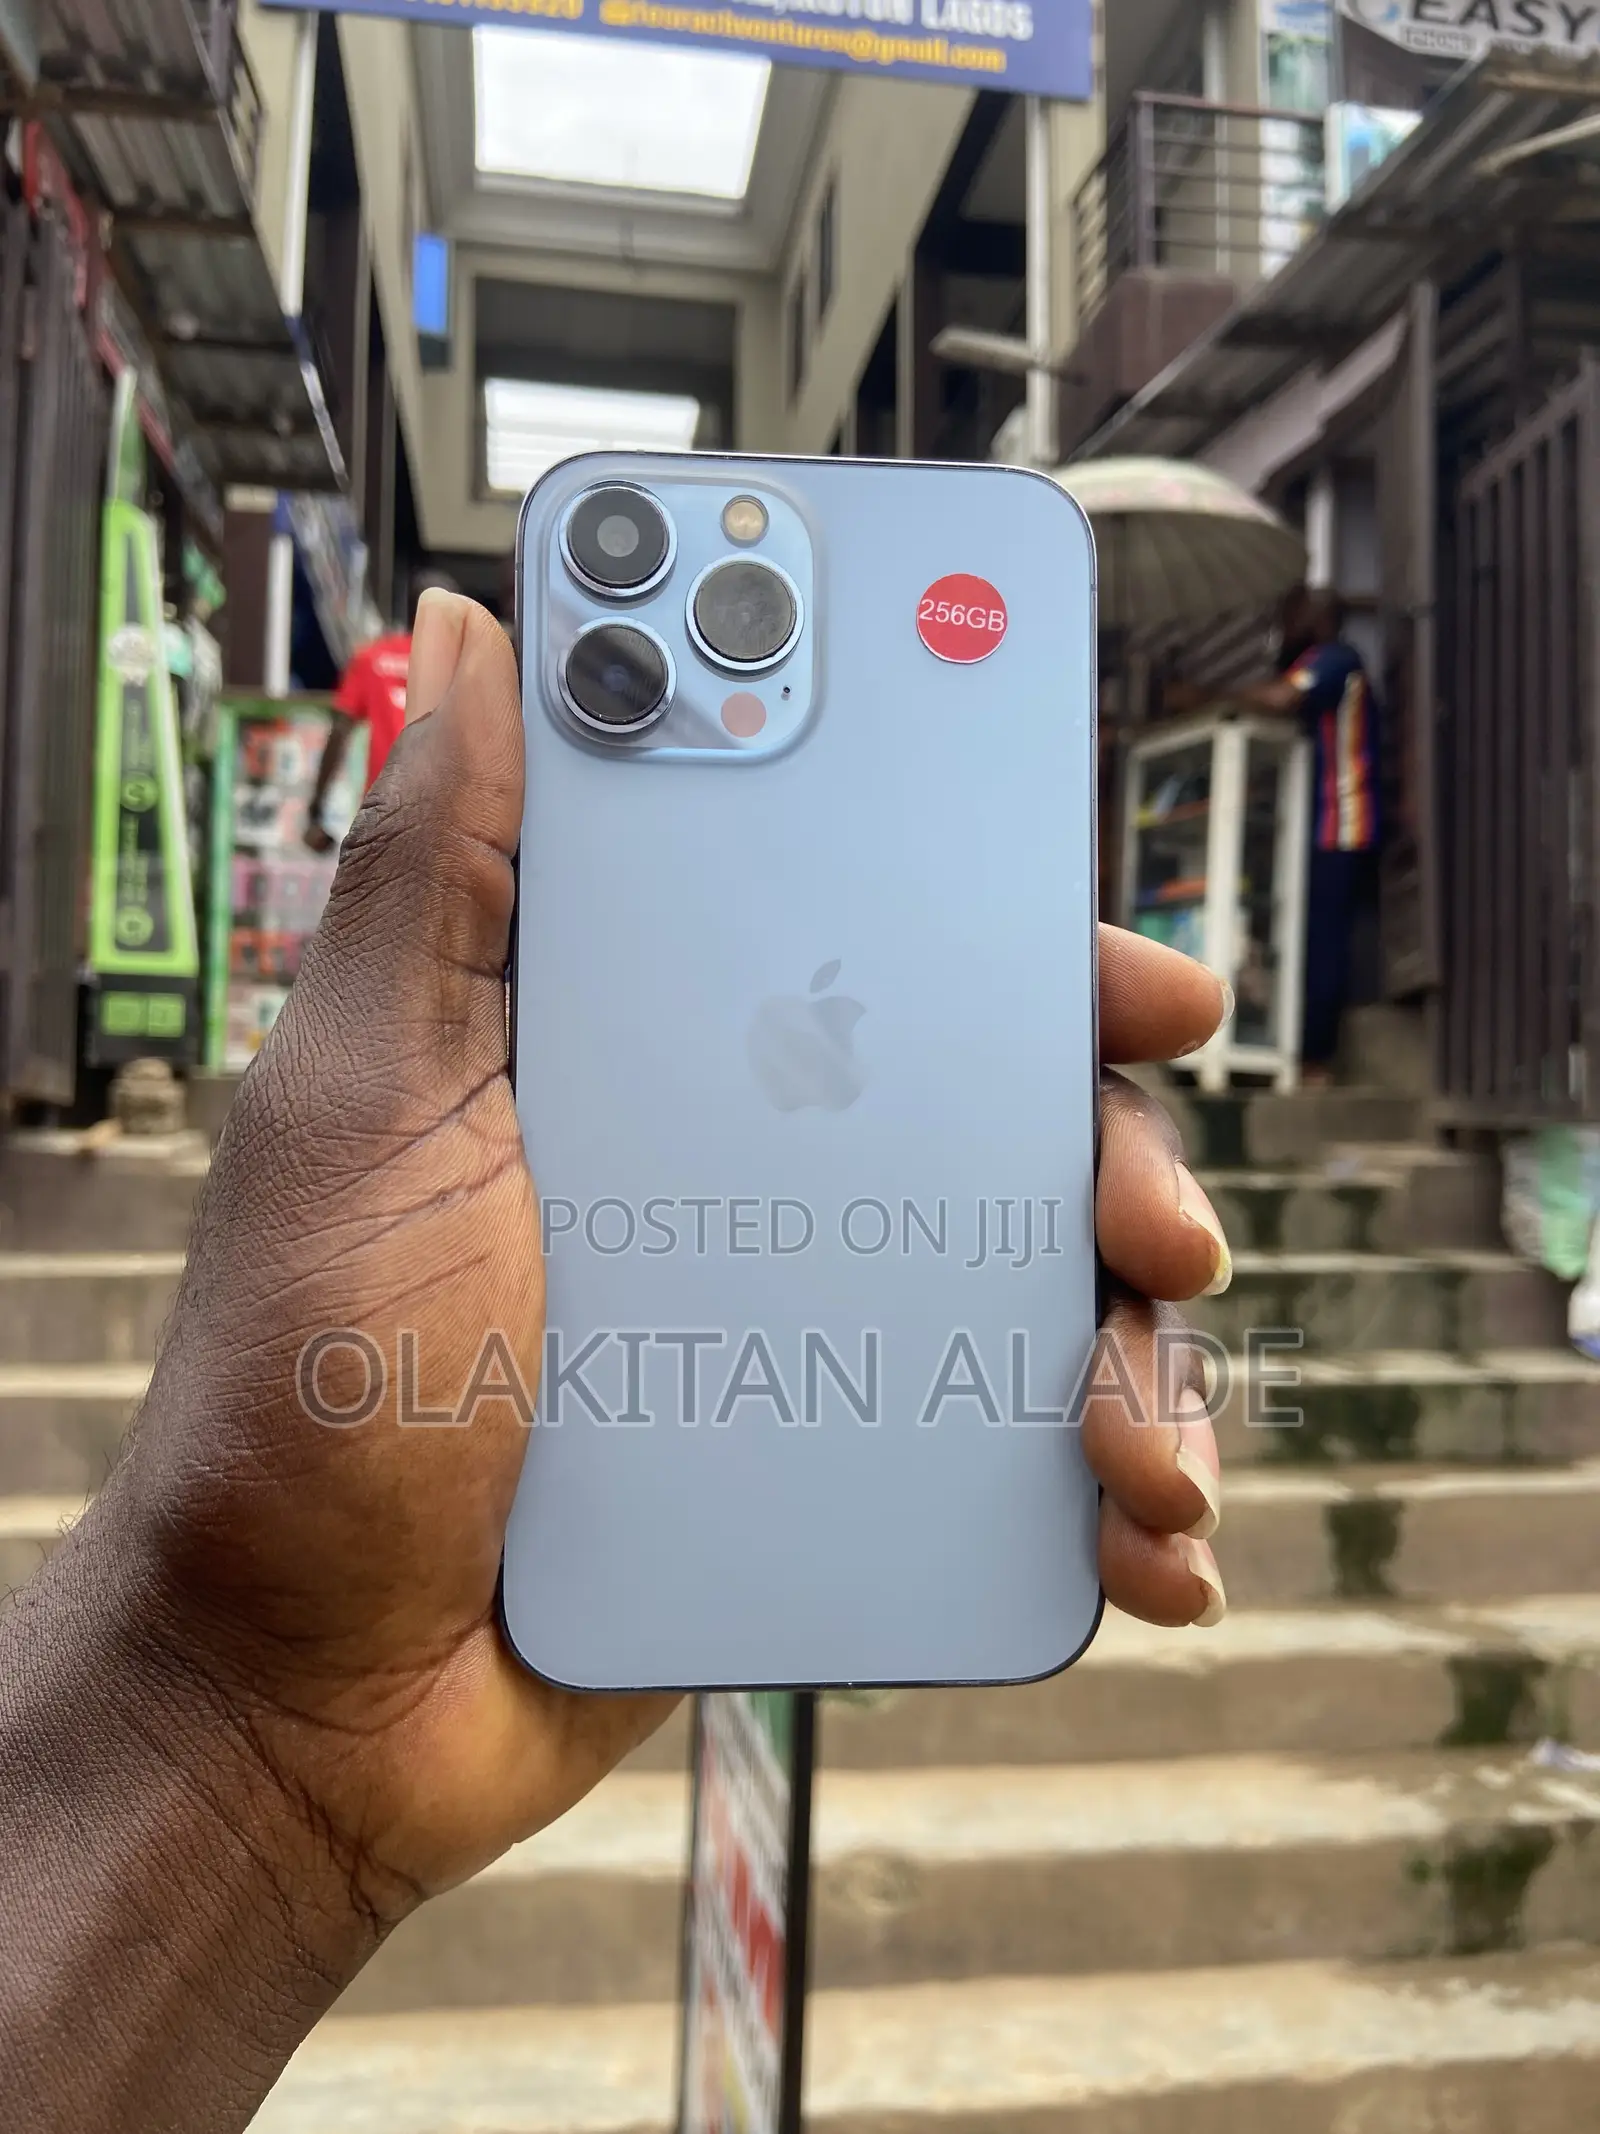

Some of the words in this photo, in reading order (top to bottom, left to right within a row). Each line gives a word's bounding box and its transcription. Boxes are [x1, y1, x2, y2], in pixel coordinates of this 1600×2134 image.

[920, 0, 1034, 41] LAGOS
[1411, 0, 1597, 43] EASY
[919, 598, 1006, 632] 256GB
